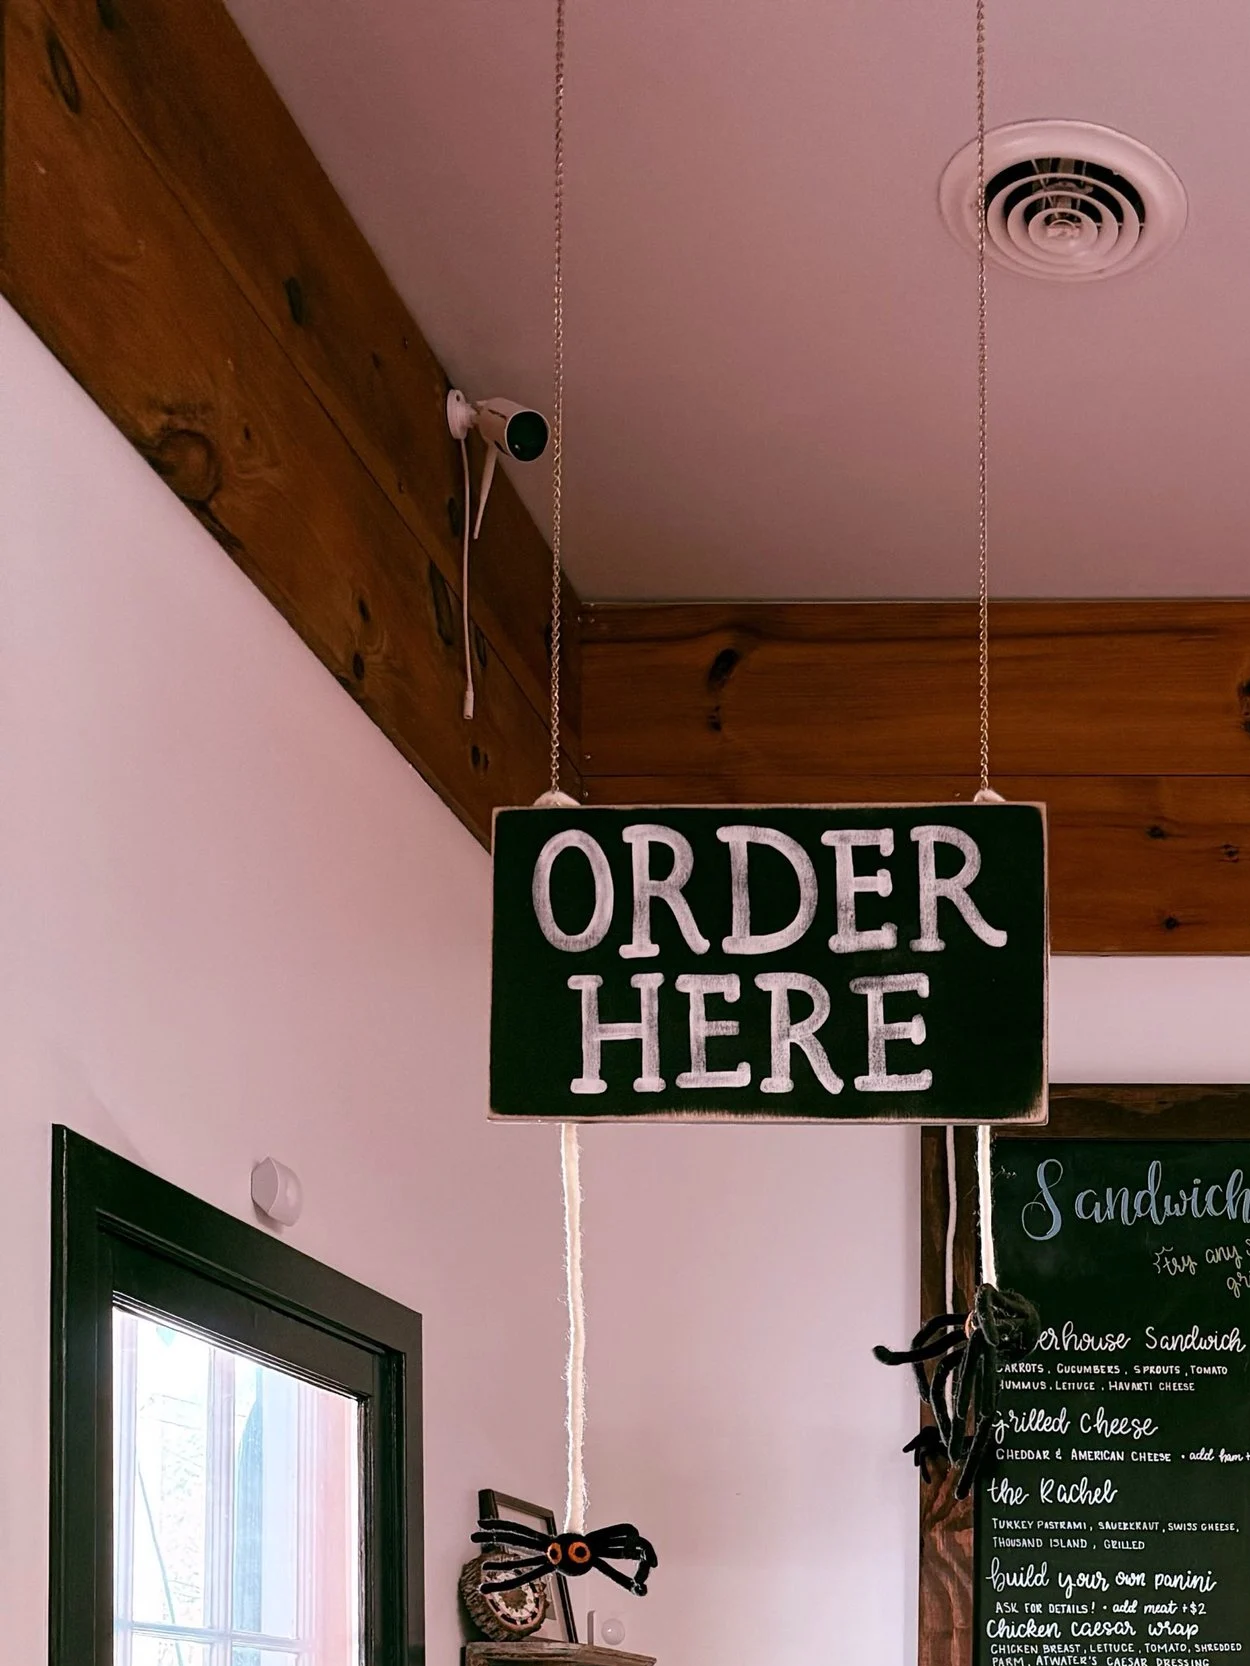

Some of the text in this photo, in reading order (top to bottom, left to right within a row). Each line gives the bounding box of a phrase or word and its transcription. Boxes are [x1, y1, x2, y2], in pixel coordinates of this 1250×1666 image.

[532, 824, 1007, 959] ORDER
[567, 972, 933, 1095] HERE
[1163, 1256, 1197, 1275] try
[1206, 1246, 1242, 1269] any
[1036, 1321, 1131, 1351] erhouse
[1146, 1325, 1246, 1352] Sandwich
[992, 1407, 1070, 1443] grilled
[996, 1449, 1050, 1459] CHEDDAR
[1072, 1449, 1124, 1461] AMERICAN
[1131, 1452, 1171, 1461] CHEESE
[1190, 1448, 1214, 1461] add
[1219, 1448, 1243, 1462] ham
[987, 1478, 1029, 1505] the
[1041, 1477, 1117, 1504] Rachel
[986, 1557, 1049, 1591] build
[1059, 1571, 1109, 1599] your
[1116, 1572, 1145, 1586] own
[1155, 1571, 1217, 1592] panini
[996, 1600, 1206, 1615] ASK FOR DETAILS! add meat +$2
[1071, 1621, 1136, 1636] caesar
[1148, 1621, 1198, 1639] wrap
[1036, 1655, 1097, 1666] ATWATER'S
[1107, 1657, 1147, 1666] CAESAR
[1157, 1658, 1209, 1666] DRESSING
